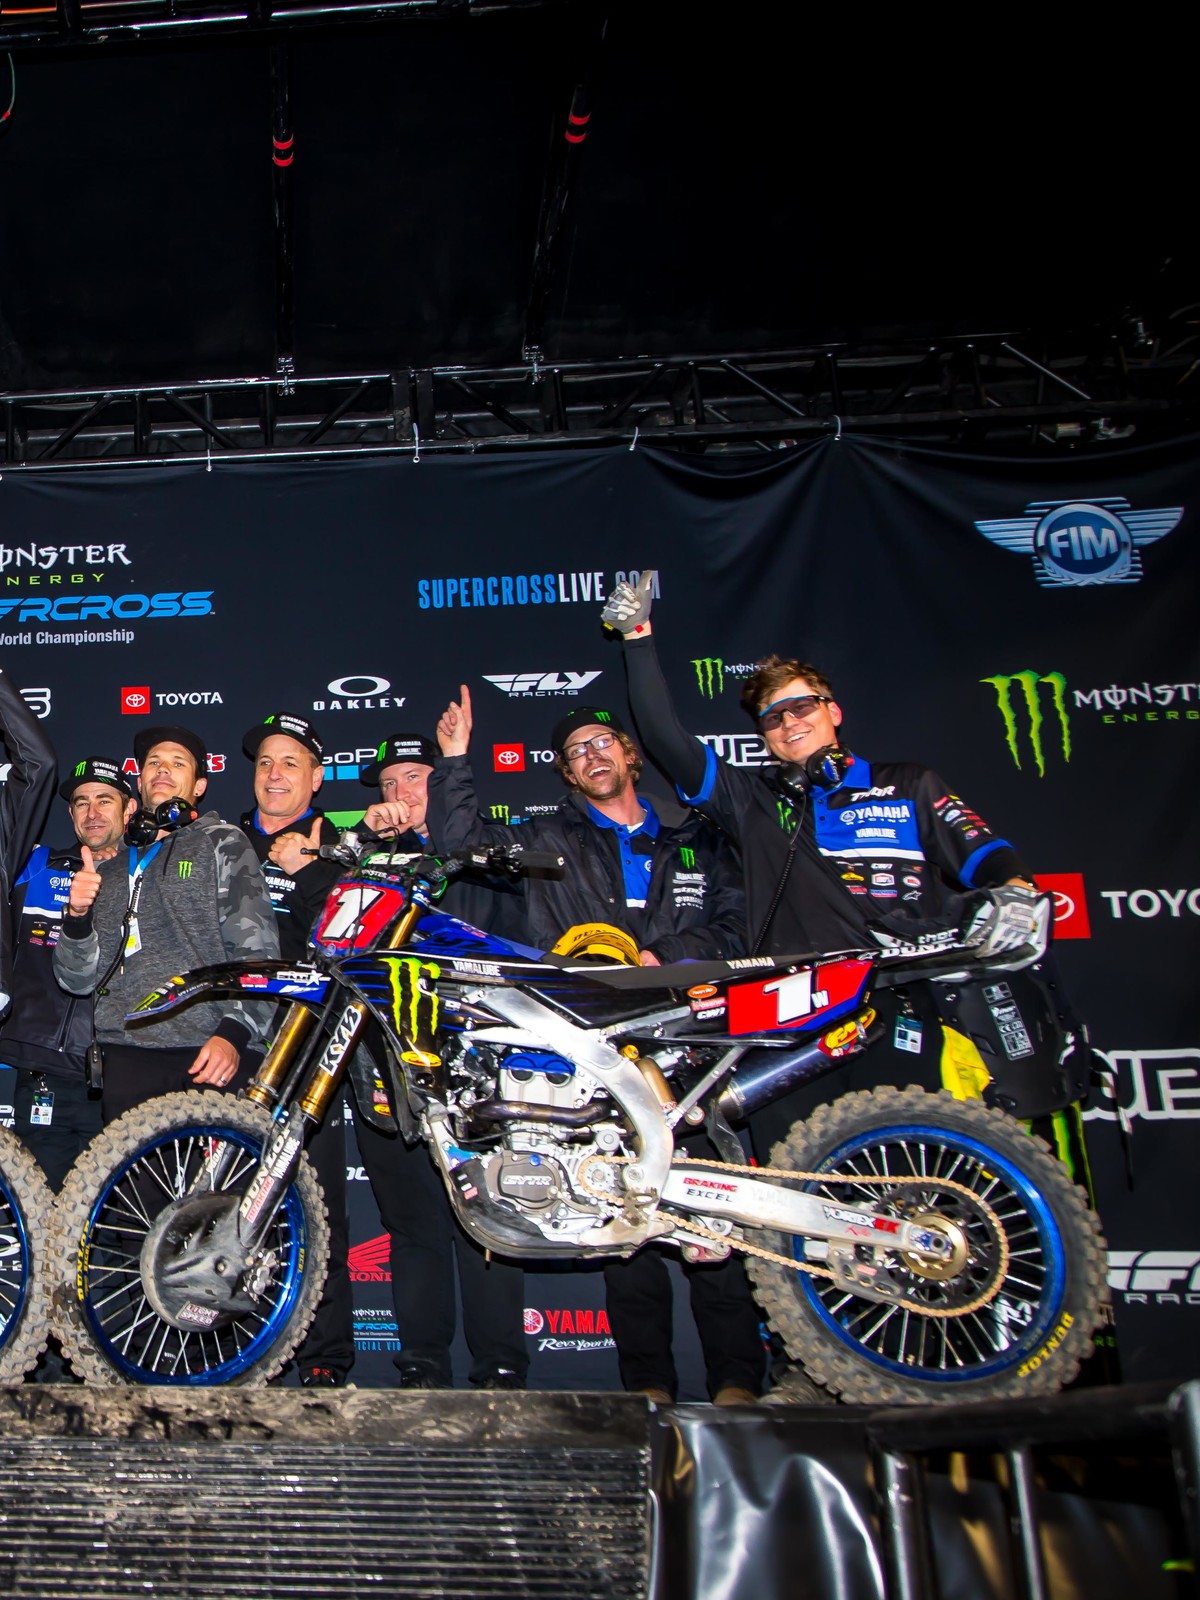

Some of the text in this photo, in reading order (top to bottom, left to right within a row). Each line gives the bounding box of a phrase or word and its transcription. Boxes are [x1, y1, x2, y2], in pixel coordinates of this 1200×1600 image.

[1049, 524, 1119, 562] FIM
[35, 630, 135, 647] Championship
[724, 662, 768, 674] MONS
[155, 691, 224, 706] TOYOTA
[508, 690, 579, 698] RACING
[1072, 682, 1200, 711] MONST
[312, 697, 407, 711] OAKLEY
[524, 804, 559, 813] MONSTE
[855, 804, 911, 819] YAMAHA
[854, 828, 897, 839] YAMALUBE
[1100, 888, 1200, 919] TOYO
[452, 960, 503, 976] YAMALUBE
[726, 956, 776, 970] YAMAHA
[763, 970, 830, 1025] 1 W
[319, 1004, 363, 1077] KYB
[270, 1139, 301, 1180] YAMALUBE
[682, 1176, 738, 1193] BRAKING
[686, 1188, 734, 1203] EXCEL
[822, 1205, 902, 1235] VORTEX EK
[1123, 1292, 1200, 1304] RAC
[180, 1311, 213, 1327] SPEED
[352, 1308, 393, 1317] MONSTER
[544, 1309, 612, 1335] YAMA
[354, 1341, 382, 1351] ICIAL
[1017, 1311, 1075, 1379] DUNLOP
